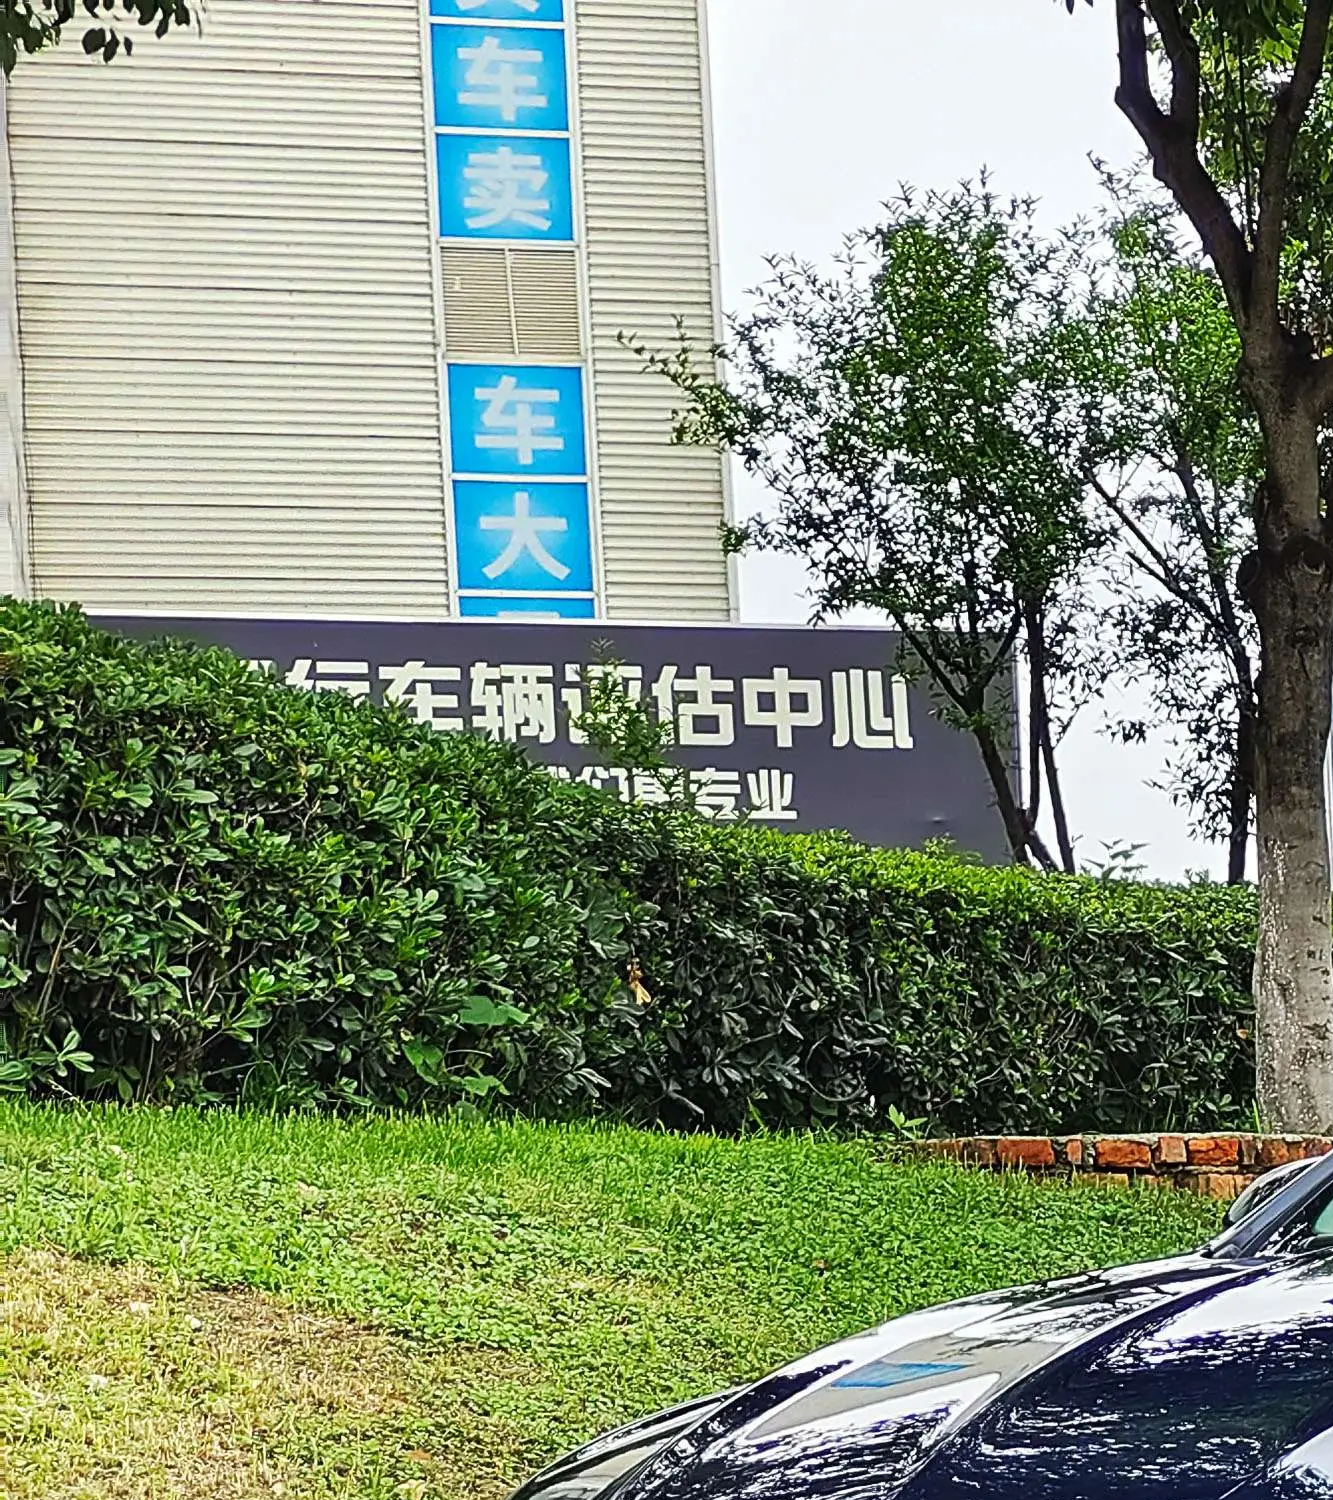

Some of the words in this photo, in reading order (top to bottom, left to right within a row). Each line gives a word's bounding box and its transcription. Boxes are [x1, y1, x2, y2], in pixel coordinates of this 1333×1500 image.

[240, 658, 914, 749] 行车辆评估中心
